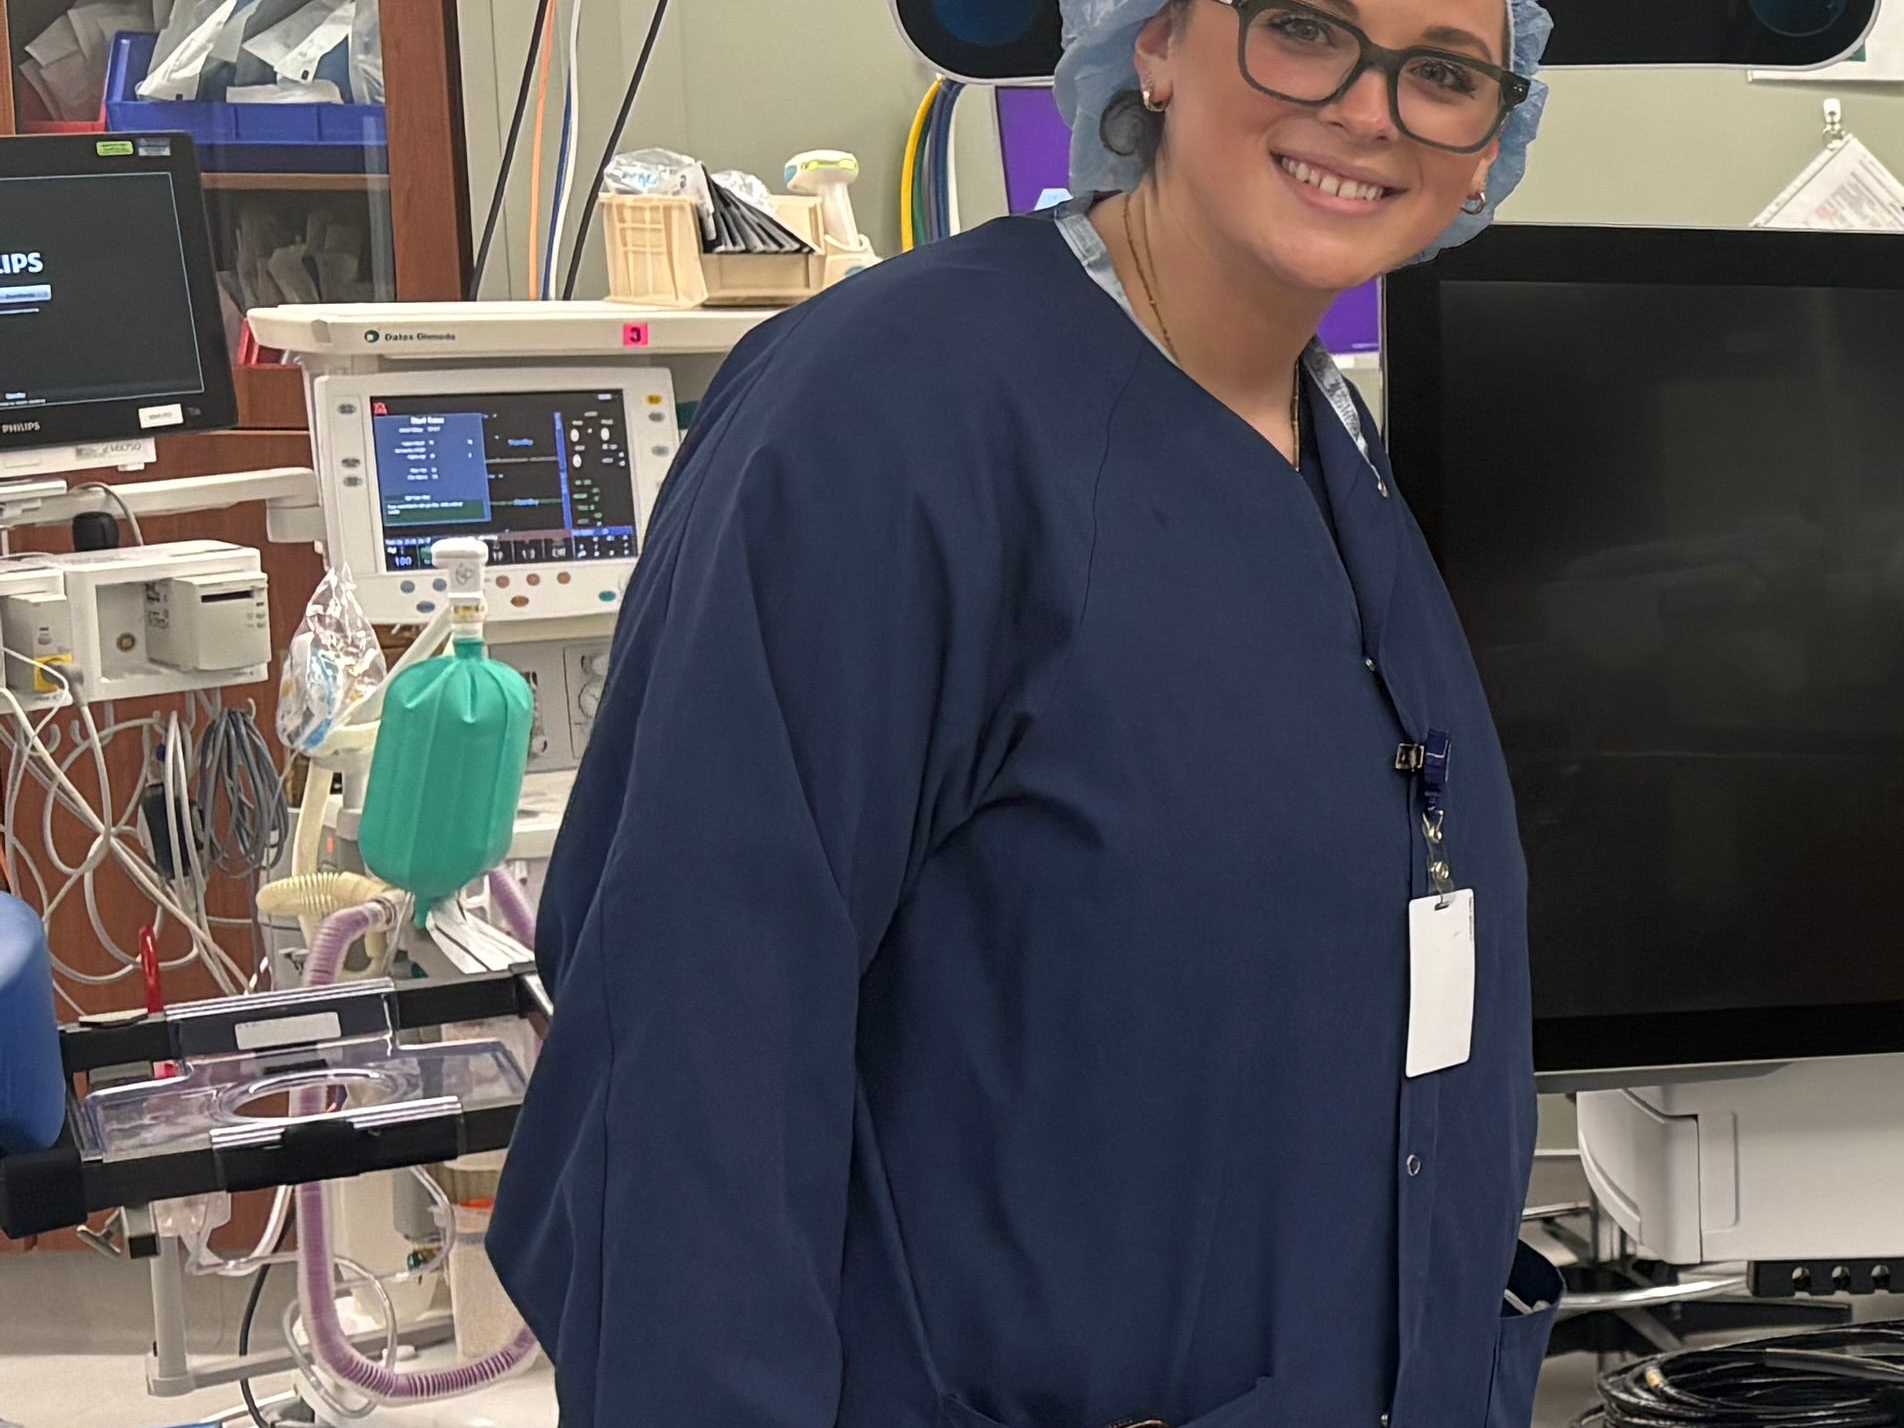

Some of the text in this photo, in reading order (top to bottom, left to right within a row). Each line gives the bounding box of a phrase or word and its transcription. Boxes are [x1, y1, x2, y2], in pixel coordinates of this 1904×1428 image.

[0, 252, 44, 274] IPS
[630, 327, 642, 343] 3
[1, 421, 41, 434] PHILIPS
